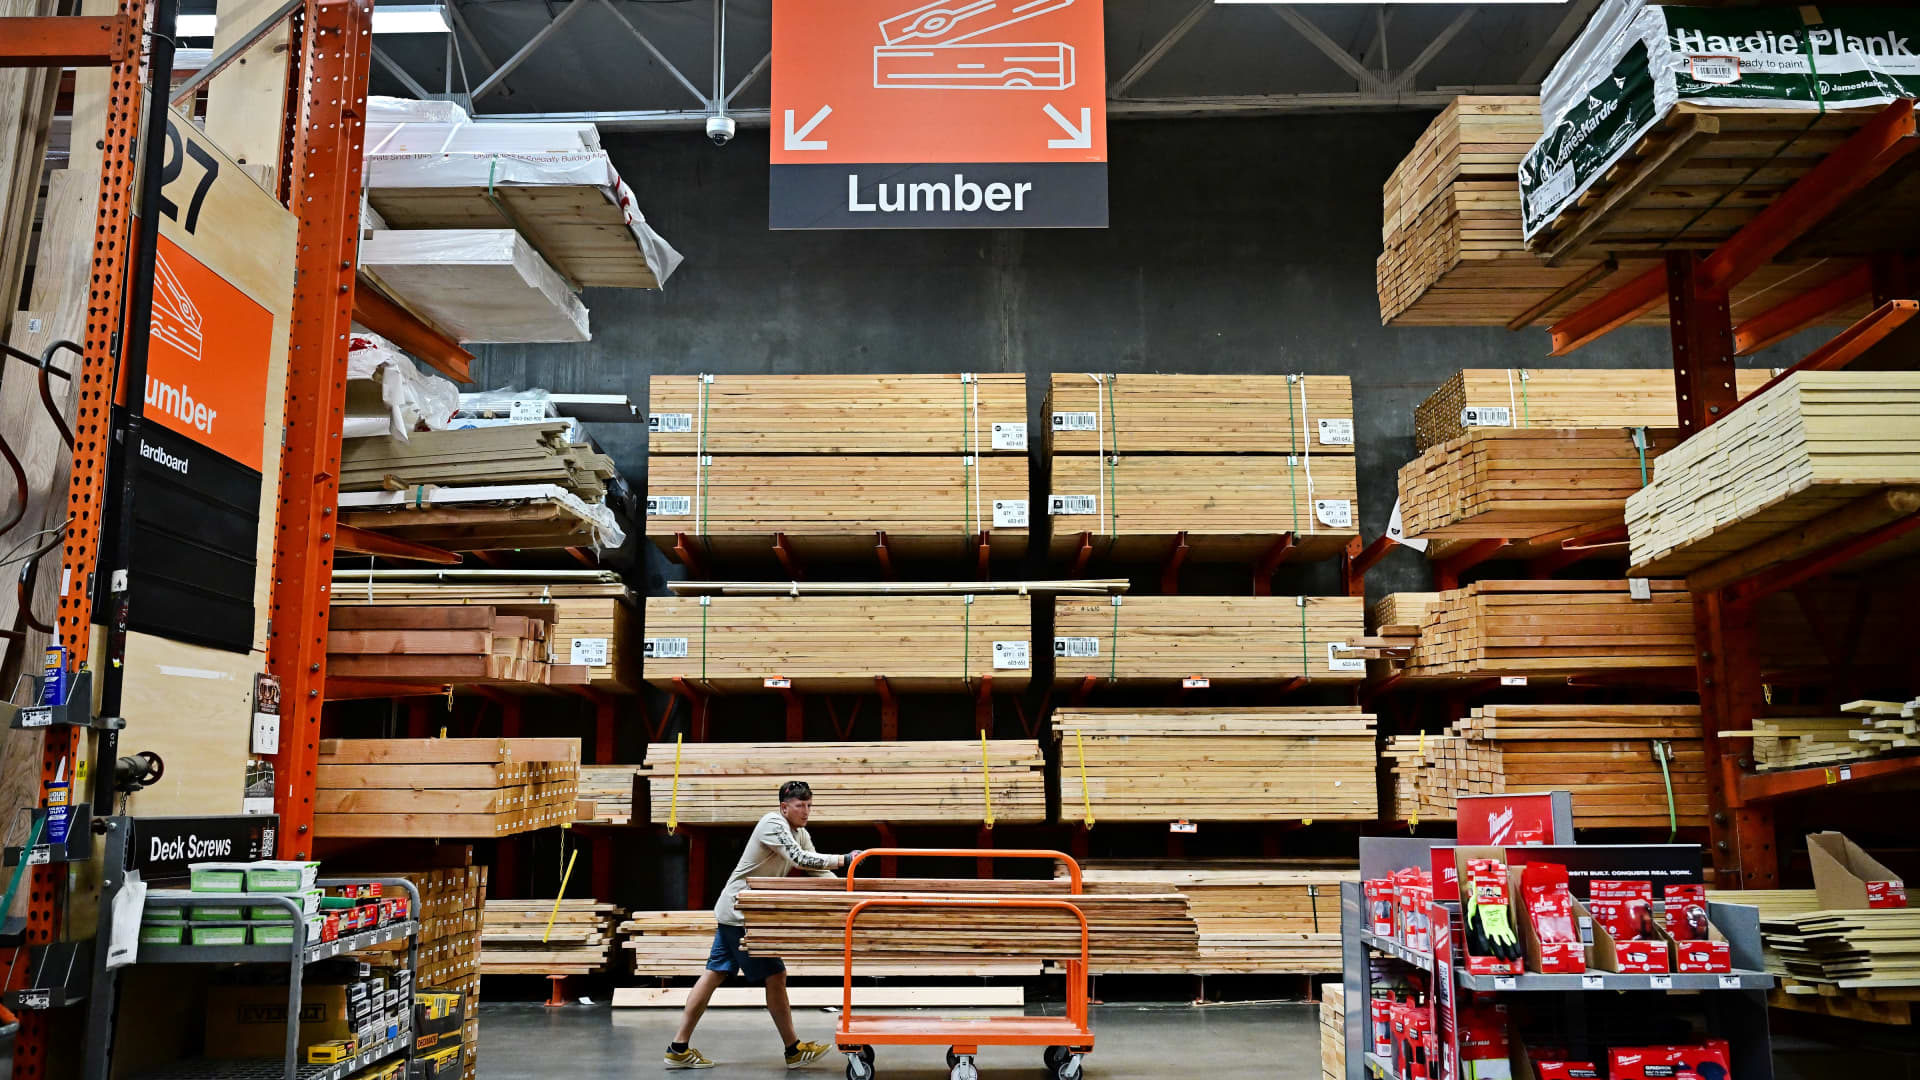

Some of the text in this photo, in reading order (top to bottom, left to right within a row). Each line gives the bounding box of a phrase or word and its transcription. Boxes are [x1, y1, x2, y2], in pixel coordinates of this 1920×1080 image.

[1676, 27, 1912, 55] Hardie Plank
[1739, 59, 1763, 68] eady
[1767, 59, 1775, 67] to
[1779, 60, 1803, 69] paint
[1832, 80, 1888, 92] JamesHardie
[848, 174, 1032, 212] Lumber
[144, 373, 217, 435] umber
[139, 438, 189, 474] ardboard
[150, 835, 185, 862] Deck
[187, 834, 232, 859] Screws
[240, 1007, 323, 1019] EVERLT
